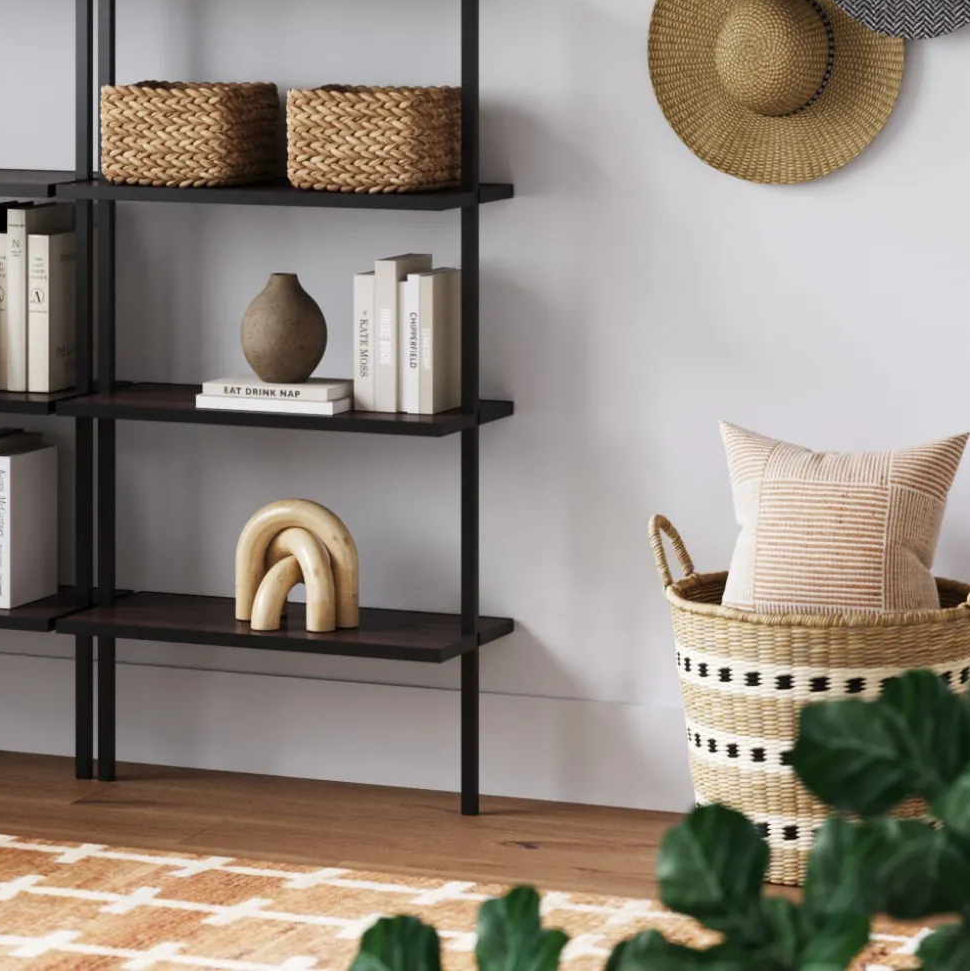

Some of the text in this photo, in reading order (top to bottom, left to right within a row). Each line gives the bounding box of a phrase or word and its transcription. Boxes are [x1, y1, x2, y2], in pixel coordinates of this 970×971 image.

[360, 318, 368, 378] KATE MOSS
[380, 340, 392, 366] BOOK
[224, 386, 301, 398] EAT DRINK NAP
